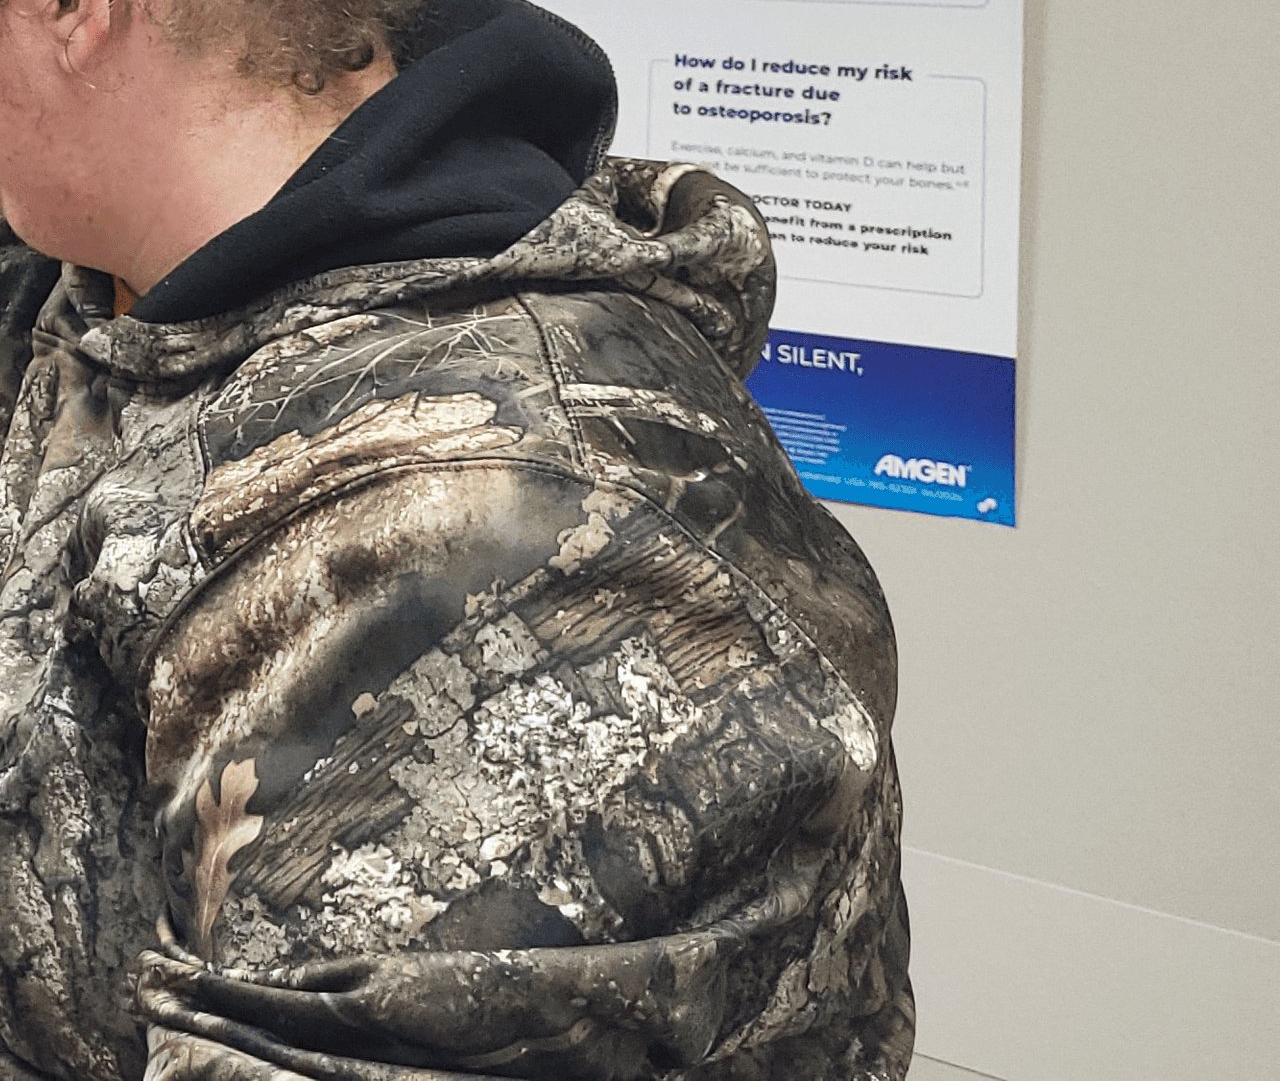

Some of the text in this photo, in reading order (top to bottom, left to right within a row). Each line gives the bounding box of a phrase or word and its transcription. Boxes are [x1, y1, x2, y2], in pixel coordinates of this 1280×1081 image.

[674, 54, 716, 69] How
[722, 57, 745, 70] do
[762, 59, 831, 76] reduce
[837, 66, 868, 82] my
[874, 64, 913, 82] risk
[673, 77, 840, 101] of a fracture due
[673, 102, 832, 126] to osteoporosis?
[877, 160, 902, 169] can
[906, 160, 937, 173] help
[941, 162, 965, 175] but
[752, 195, 852, 212] OCTOR TODAY
[765, 216, 805, 227] enefit
[810, 220, 843, 231] from
[860, 224, 952, 240] prescription
[791, 233, 805, 242] to
[809, 236, 858, 248] reduce
[863, 241, 896, 252] your
[901, 242, 929, 255] risk
[777, 344, 864, 375] SILENT,
